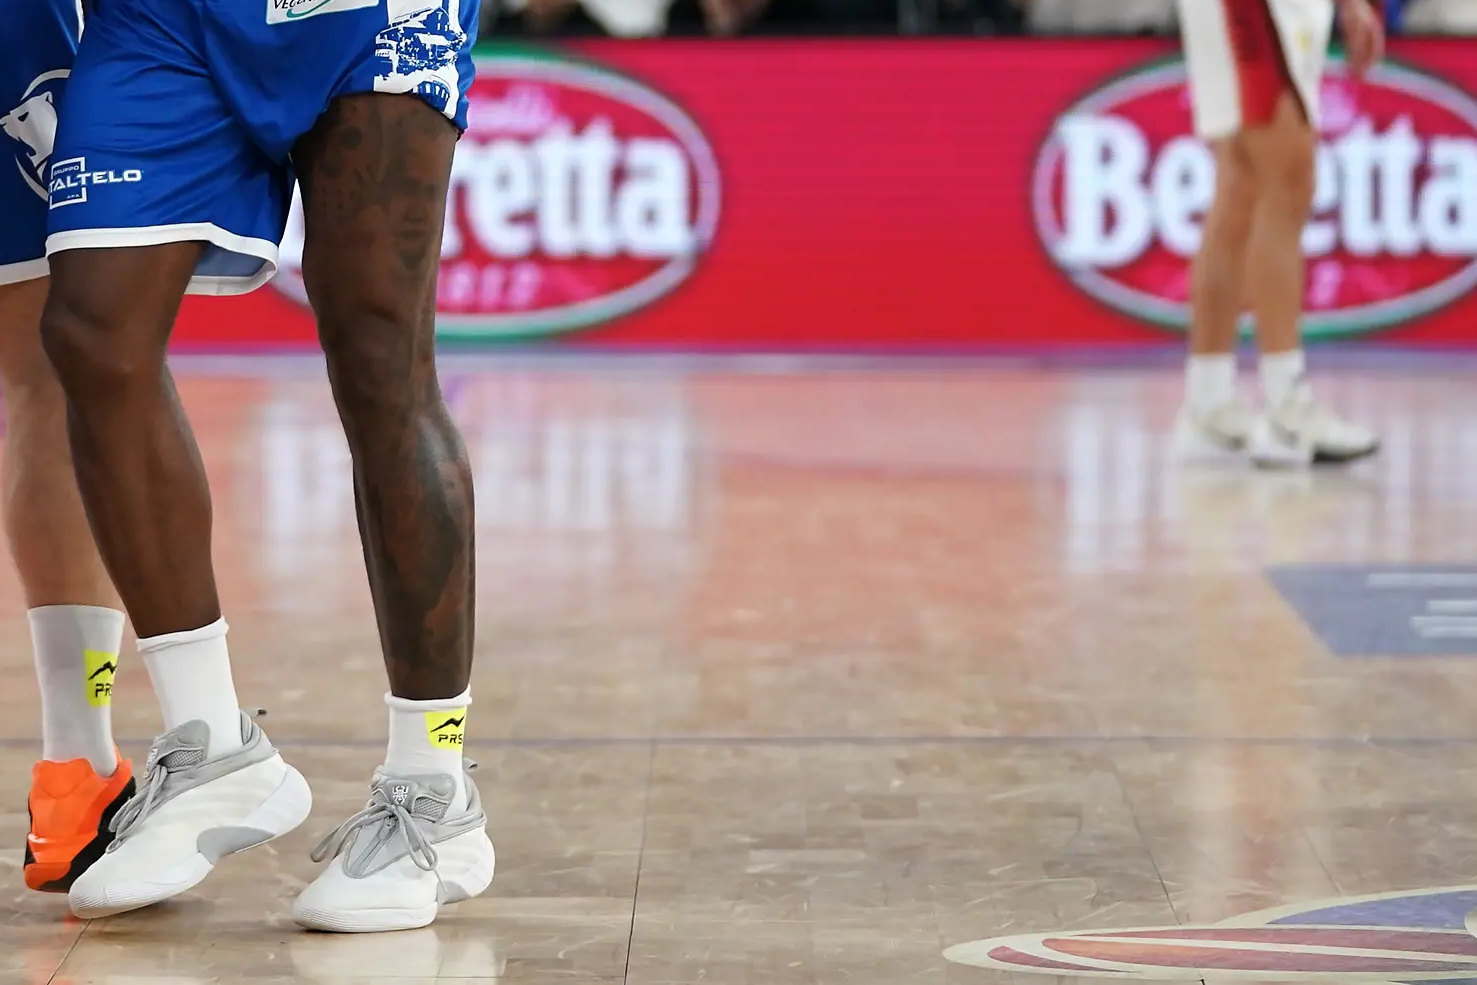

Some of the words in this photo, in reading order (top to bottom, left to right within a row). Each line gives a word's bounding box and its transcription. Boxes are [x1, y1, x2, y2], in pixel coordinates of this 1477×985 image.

[440, 113, 696, 261] retta
[1056, 113, 1477, 266] Betta
[437, 732, 464, 745] PRS
